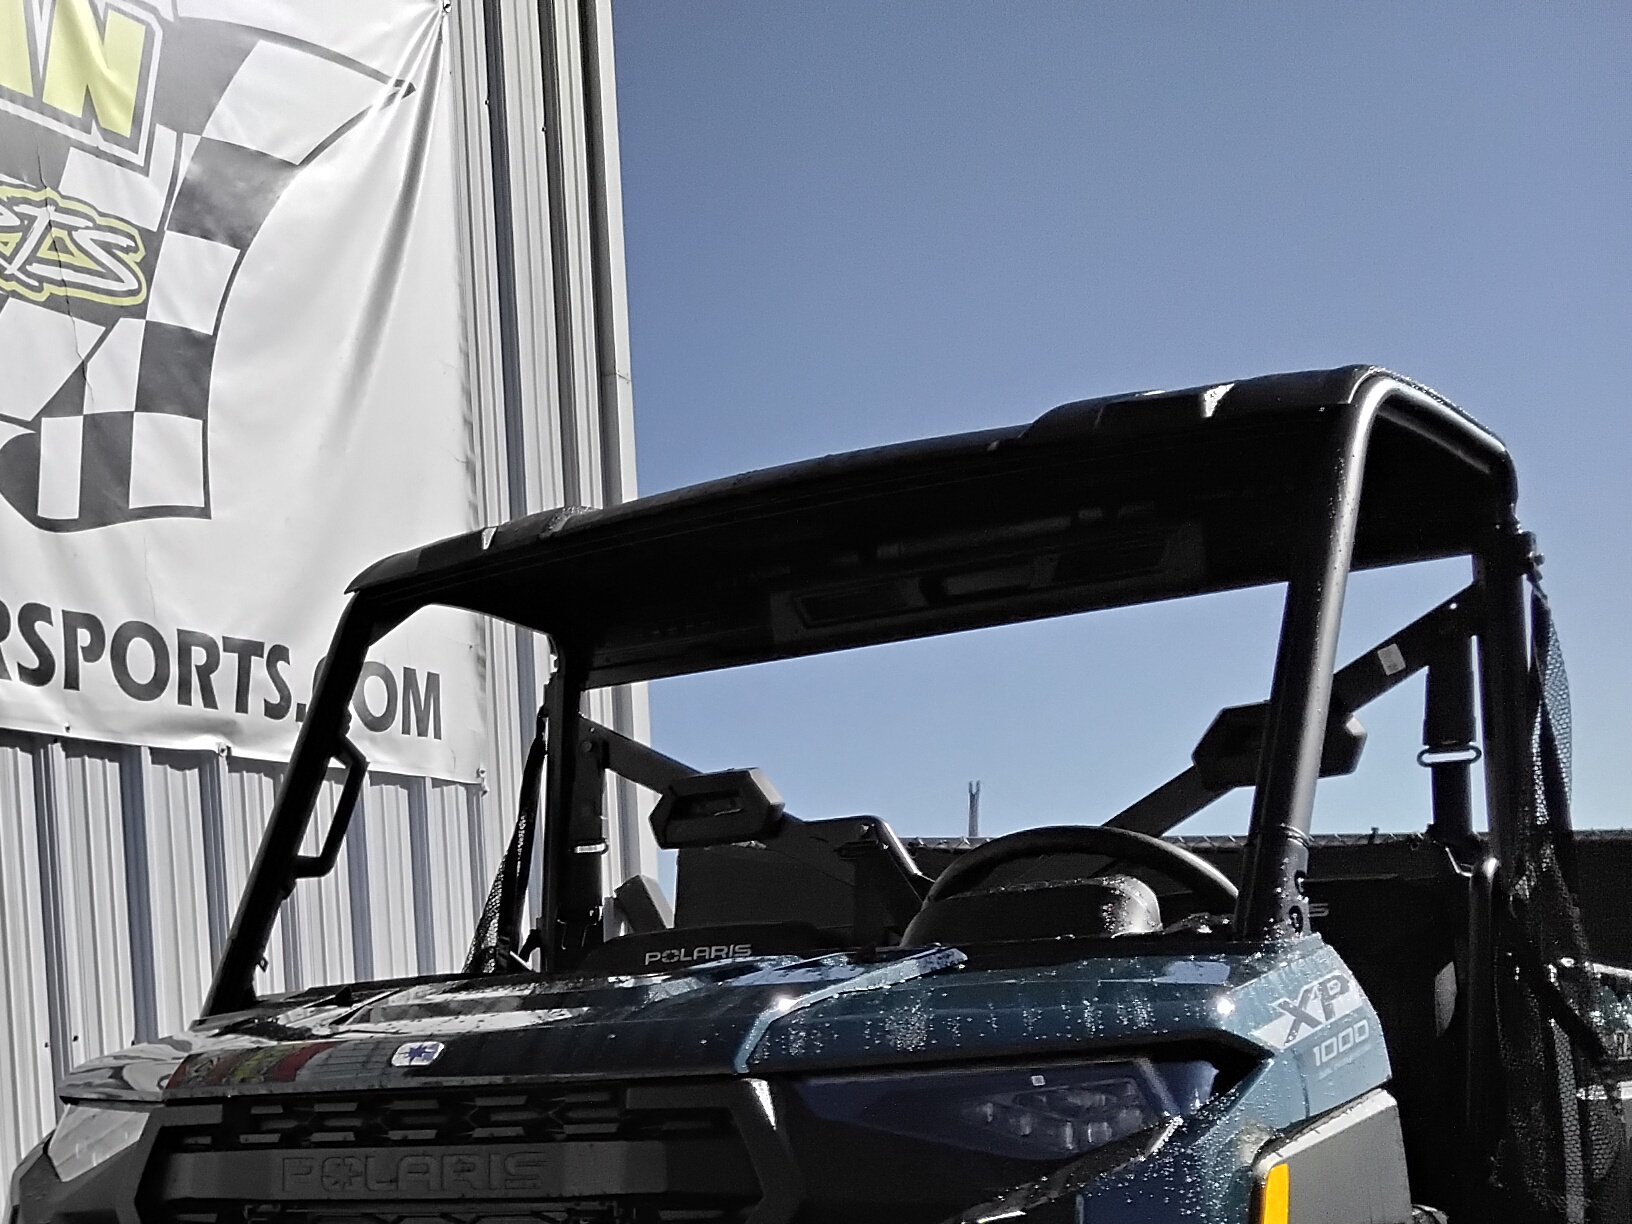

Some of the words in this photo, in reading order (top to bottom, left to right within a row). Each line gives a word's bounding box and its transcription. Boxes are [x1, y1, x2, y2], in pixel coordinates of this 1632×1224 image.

[645, 944, 752, 966] POLARIS
[1271, 970, 1352, 1047] XP
[1312, 1019, 1370, 1067] 1000
[282, 1151, 552, 1193] POLARIS
